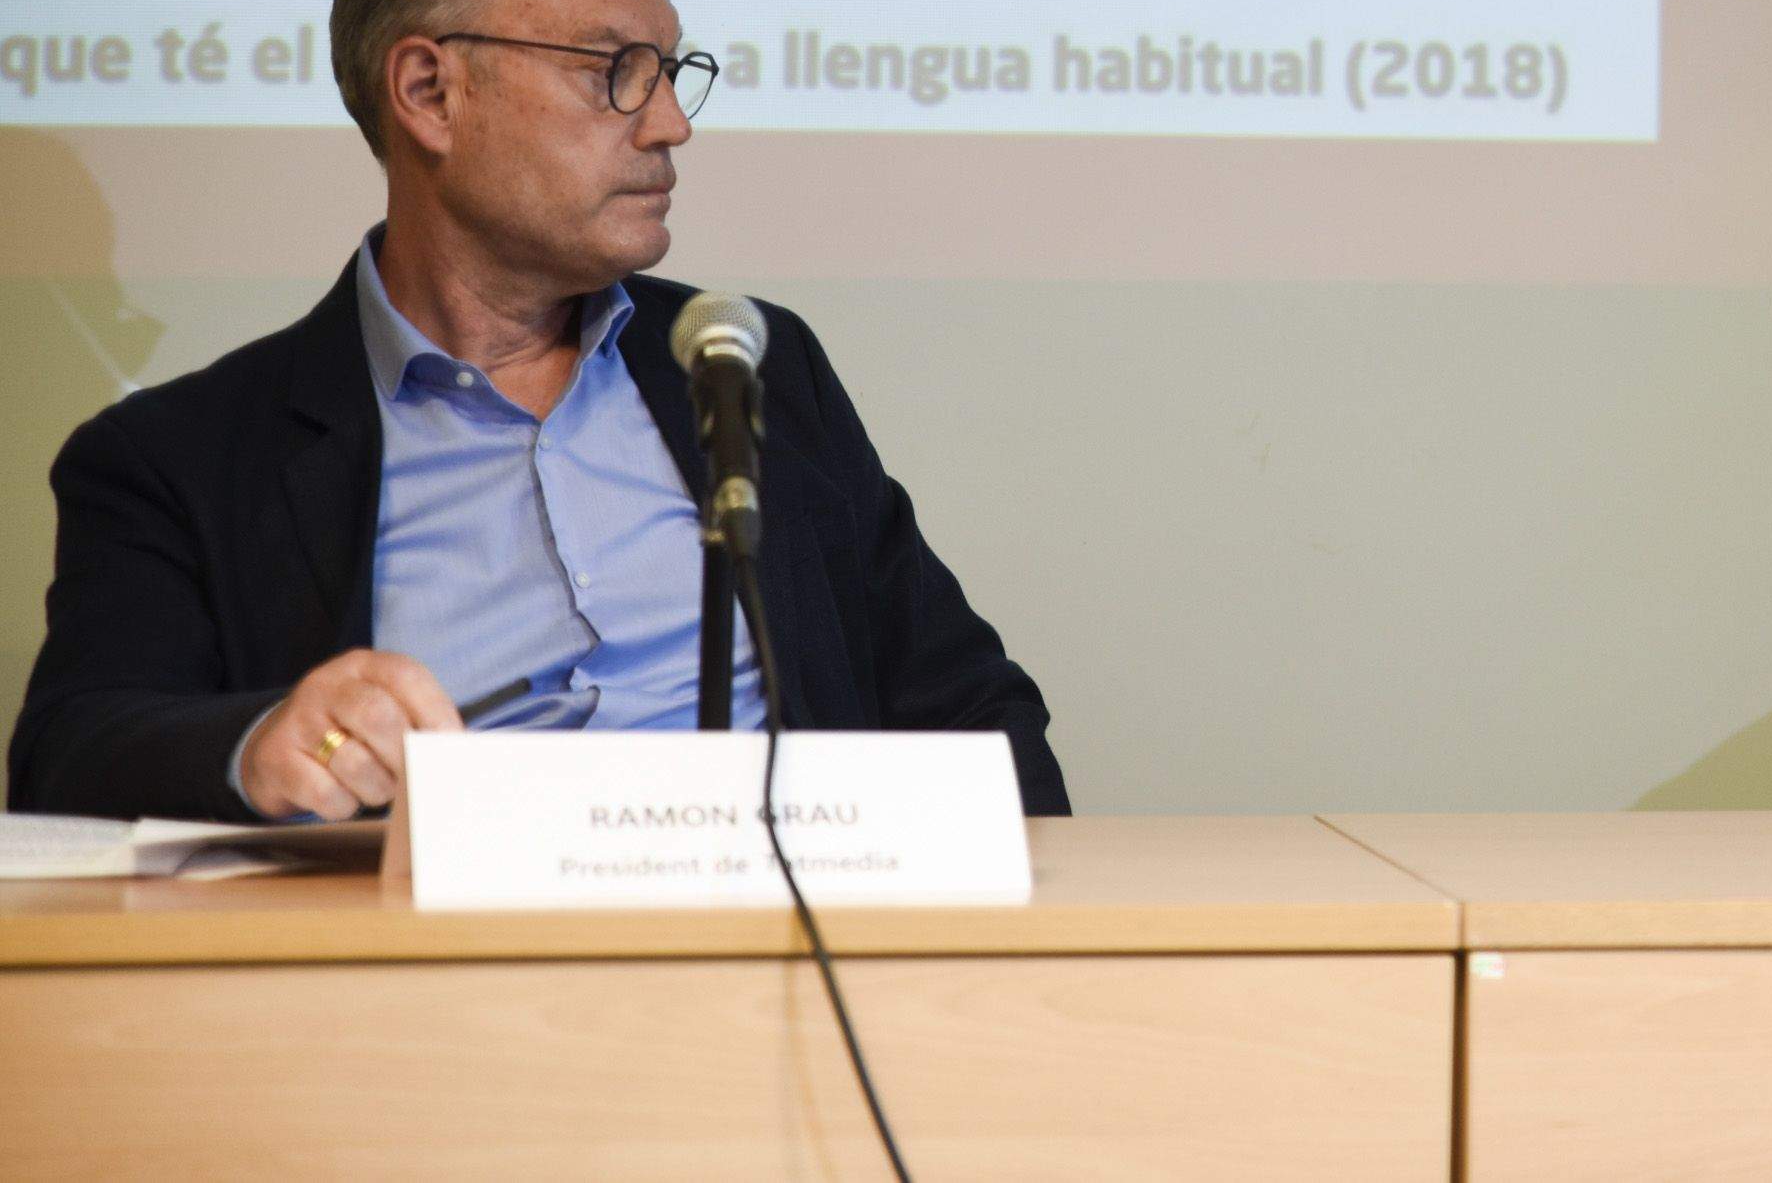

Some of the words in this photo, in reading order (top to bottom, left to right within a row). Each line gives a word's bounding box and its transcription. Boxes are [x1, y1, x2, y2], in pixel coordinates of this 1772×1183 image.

[0, 34, 133, 98] que
[154, 21, 230, 84] té
[253, 22, 315, 84] el
[723, 40, 762, 88] a
[783, 27, 1033, 106] llengua
[1052, 33, 1325, 98] habitual
[1345, 39, 1570, 114] (2018)
[589, 805, 738, 829] RAMON
[558, 855, 701, 878] President
[712, 854, 750, 877] de
